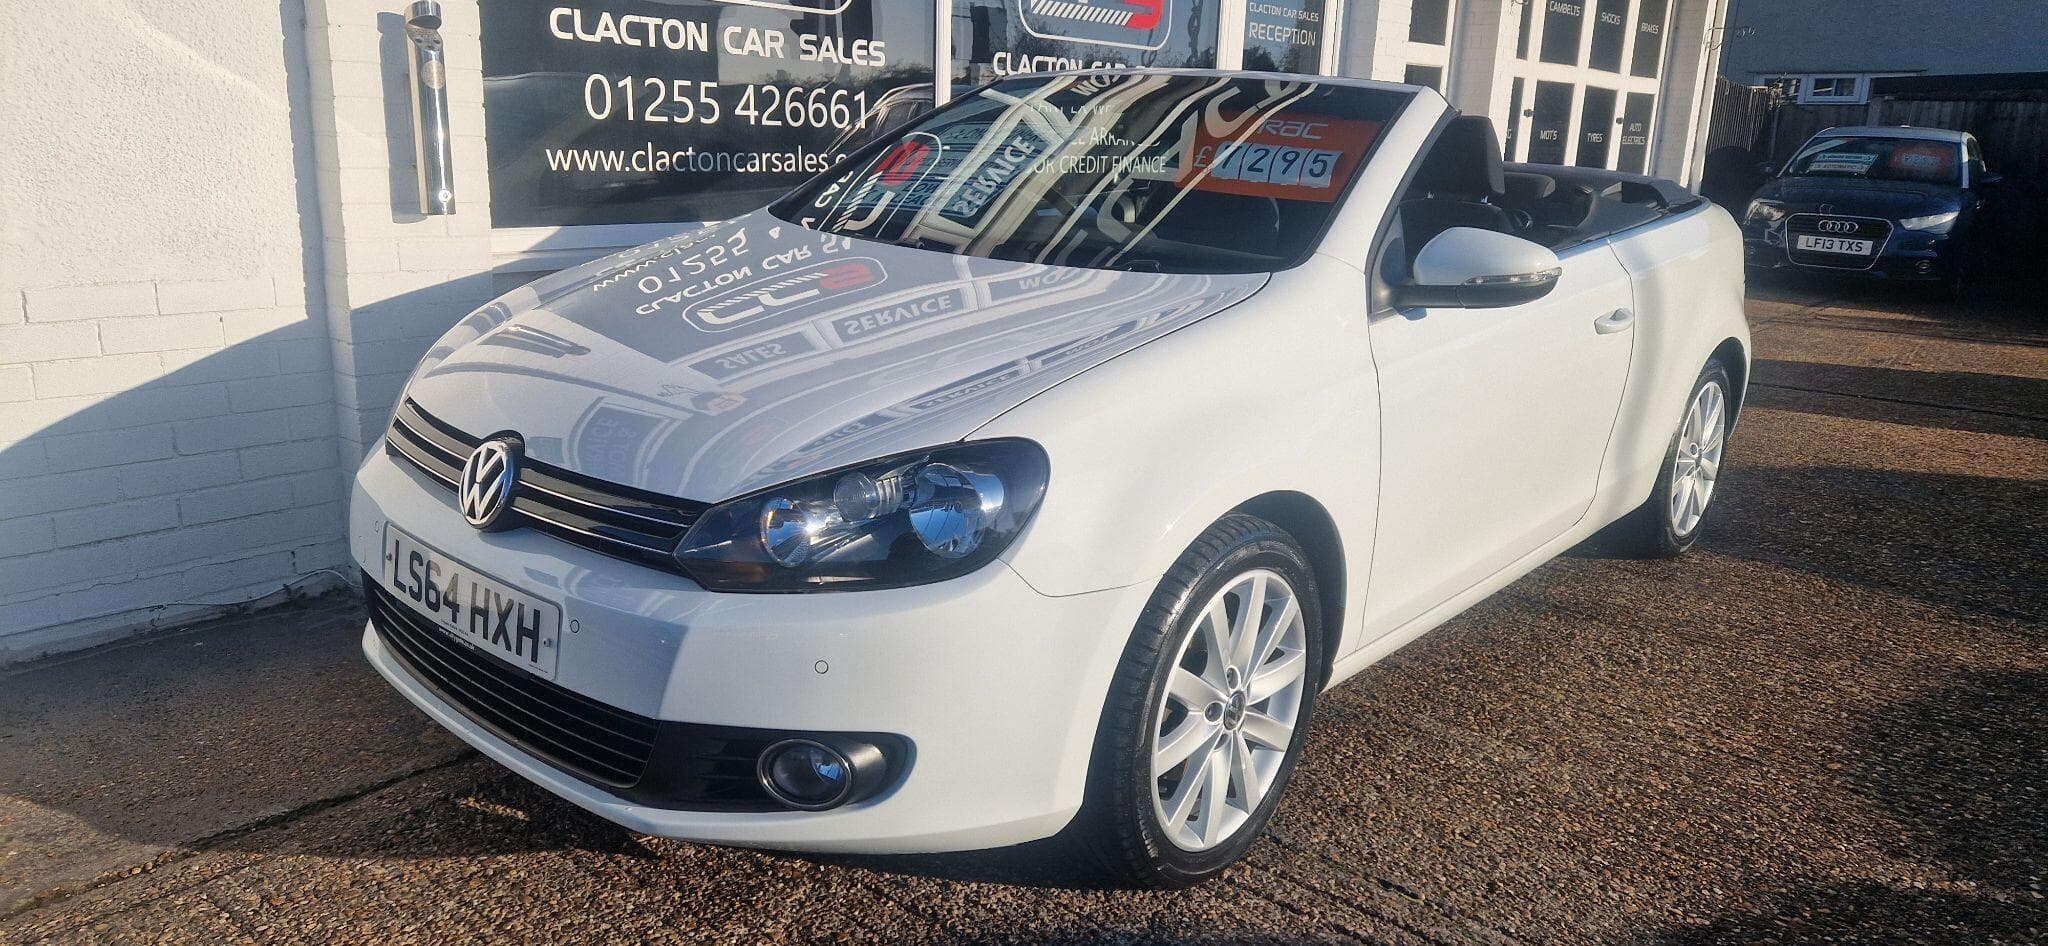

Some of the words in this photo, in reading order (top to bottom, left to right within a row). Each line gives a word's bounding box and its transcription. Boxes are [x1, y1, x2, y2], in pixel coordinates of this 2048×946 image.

[1249, 2, 1281, 16] CLACTON
[1283, 8, 1297, 18] CAR
[1298, 11, 1319, 21] SALES
[1601, 12, 1621, 25] SHOCKS
[549, 7, 708, 52] CLACTON
[723, 25, 785, 59] CAR
[799, 33, 886, 67] SALES
[1248, 22, 1317, 46] RECEPTION
[584, 73, 720, 124] 01255
[734, 84, 867, 129] 426661
[1060, 156, 1108, 174] CREDIT
[1113, 156, 1166, 175] FINANCE
[1805, 237, 1834, 250] LF13
[1838, 240, 1864, 253] TXS
[393, 539, 461, 624] LS64
[470, 581, 541, 664] HXH
